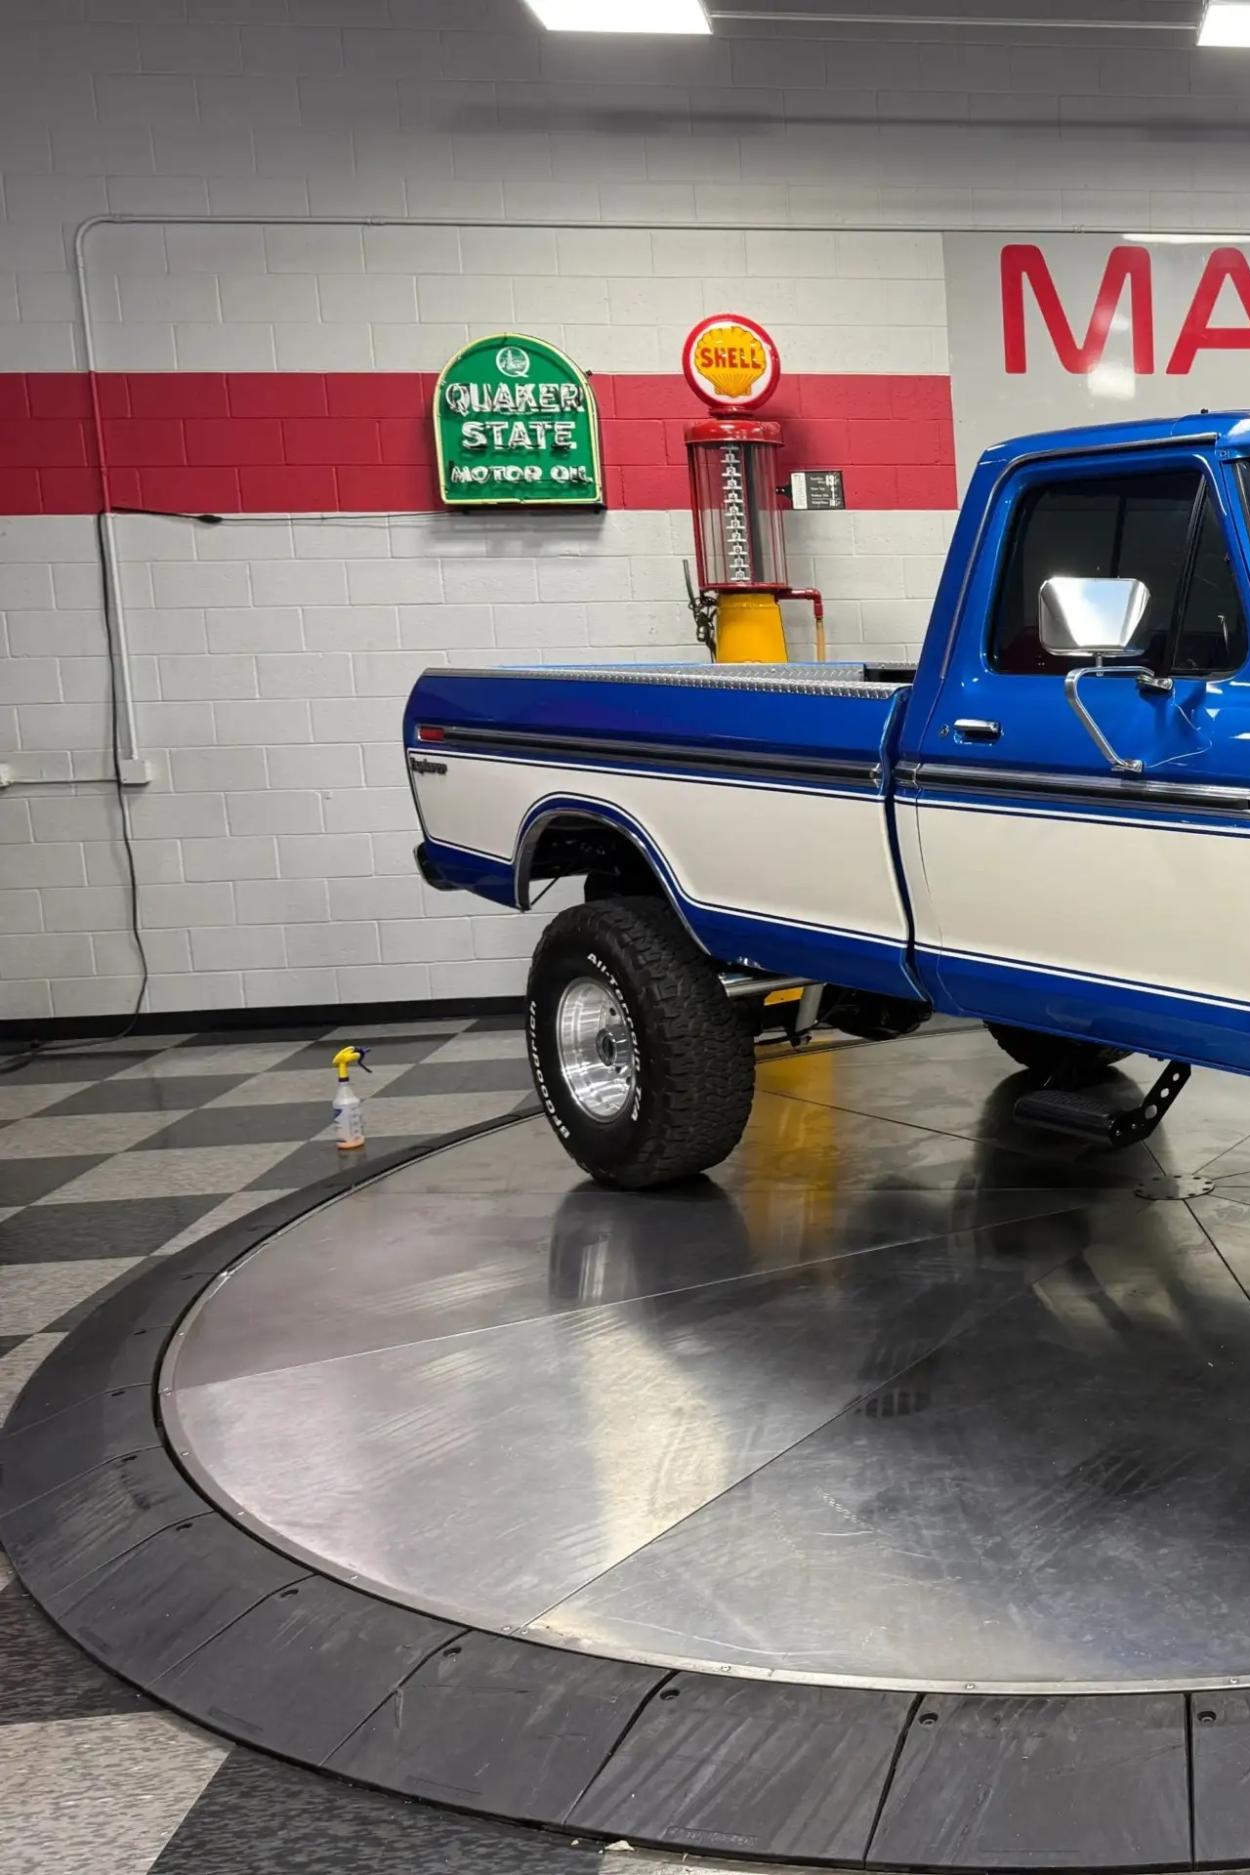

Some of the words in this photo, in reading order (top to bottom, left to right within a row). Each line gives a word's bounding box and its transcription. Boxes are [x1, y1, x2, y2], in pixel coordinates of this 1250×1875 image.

[700, 347, 762, 370] SHELL
[445, 382, 585, 416] QUAKER
[461, 421, 577, 450] STATE
[451, 464, 543, 484] MOTOR
[550, 464, 593, 484] OIL
